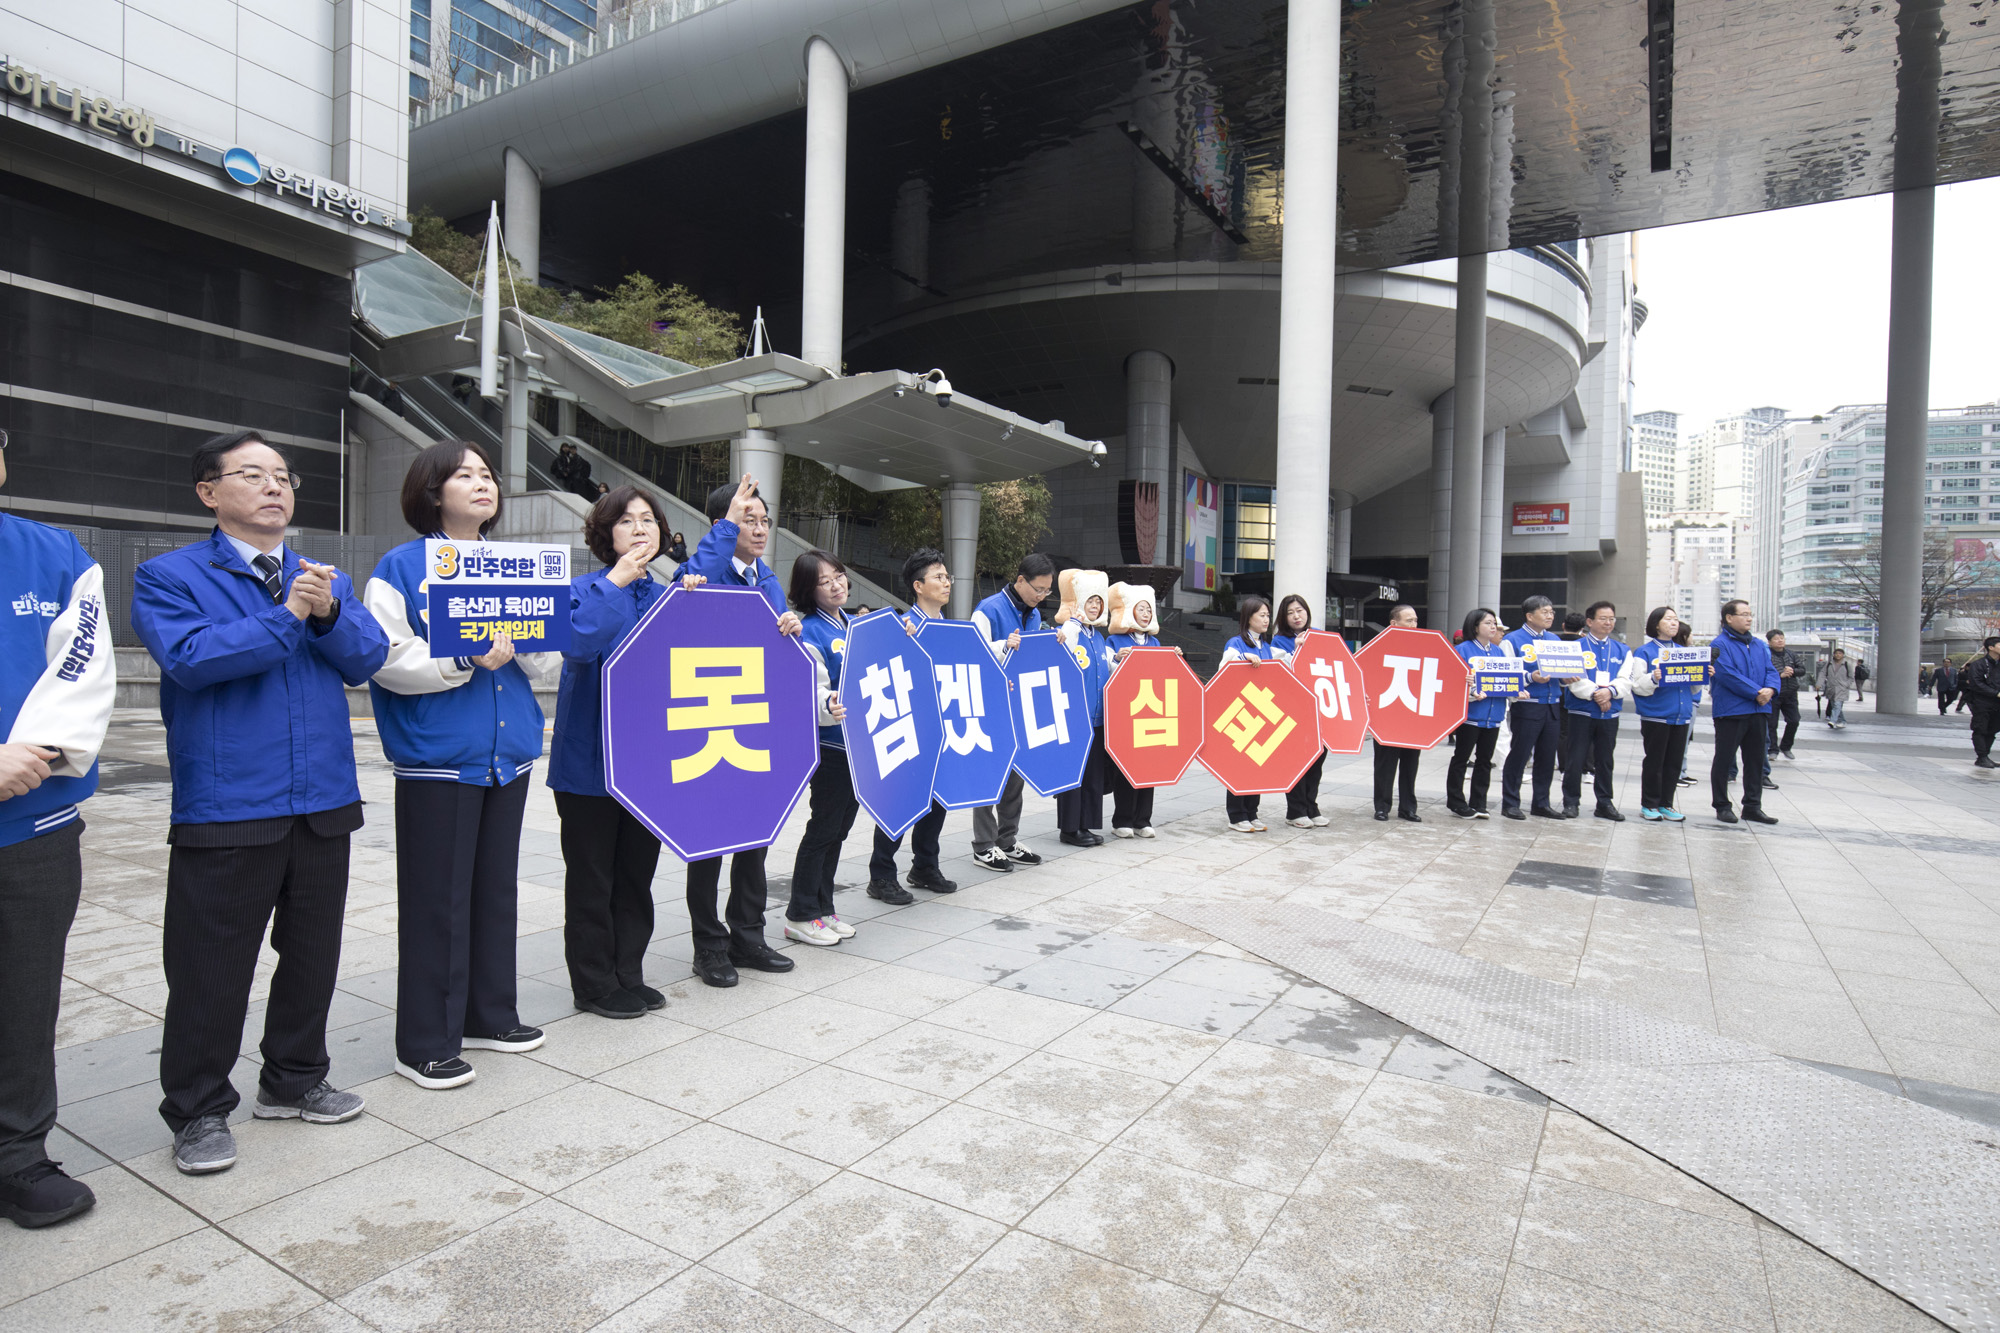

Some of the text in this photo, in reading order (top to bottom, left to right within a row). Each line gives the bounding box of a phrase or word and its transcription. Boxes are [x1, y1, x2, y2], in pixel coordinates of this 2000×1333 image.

[6, 65, 198, 155] 하나은행 1F
[266, 164, 396, 228] 우리은행 3F
[434, 544, 536, 580] 3 민주연합
[472, 547, 493, 558] 더불어
[543, 555, 562, 566] 10대
[544, 566, 562, 576] 공약
[448, 597, 555, 618] 출산과 육아의
[56, 599, 99, 682] 민주연합
[1486, 662, 1510, 670] 민주연합
[1521, 644, 1538, 663] 3
[1582, 651, 1597, 669] 3
[1671, 652, 1697, 660] 민주연합
[667, 646, 770, 784] 못
[859, 654, 920, 780] 참
[936, 663, 993, 756] 겠
[1018, 665, 1070, 750] 다
[1130, 678, 1179, 749] 심
[1310, 657, 1352, 722] 하
[1378, 654, 1443, 717] 자
[1213, 680, 1297, 767] 판
